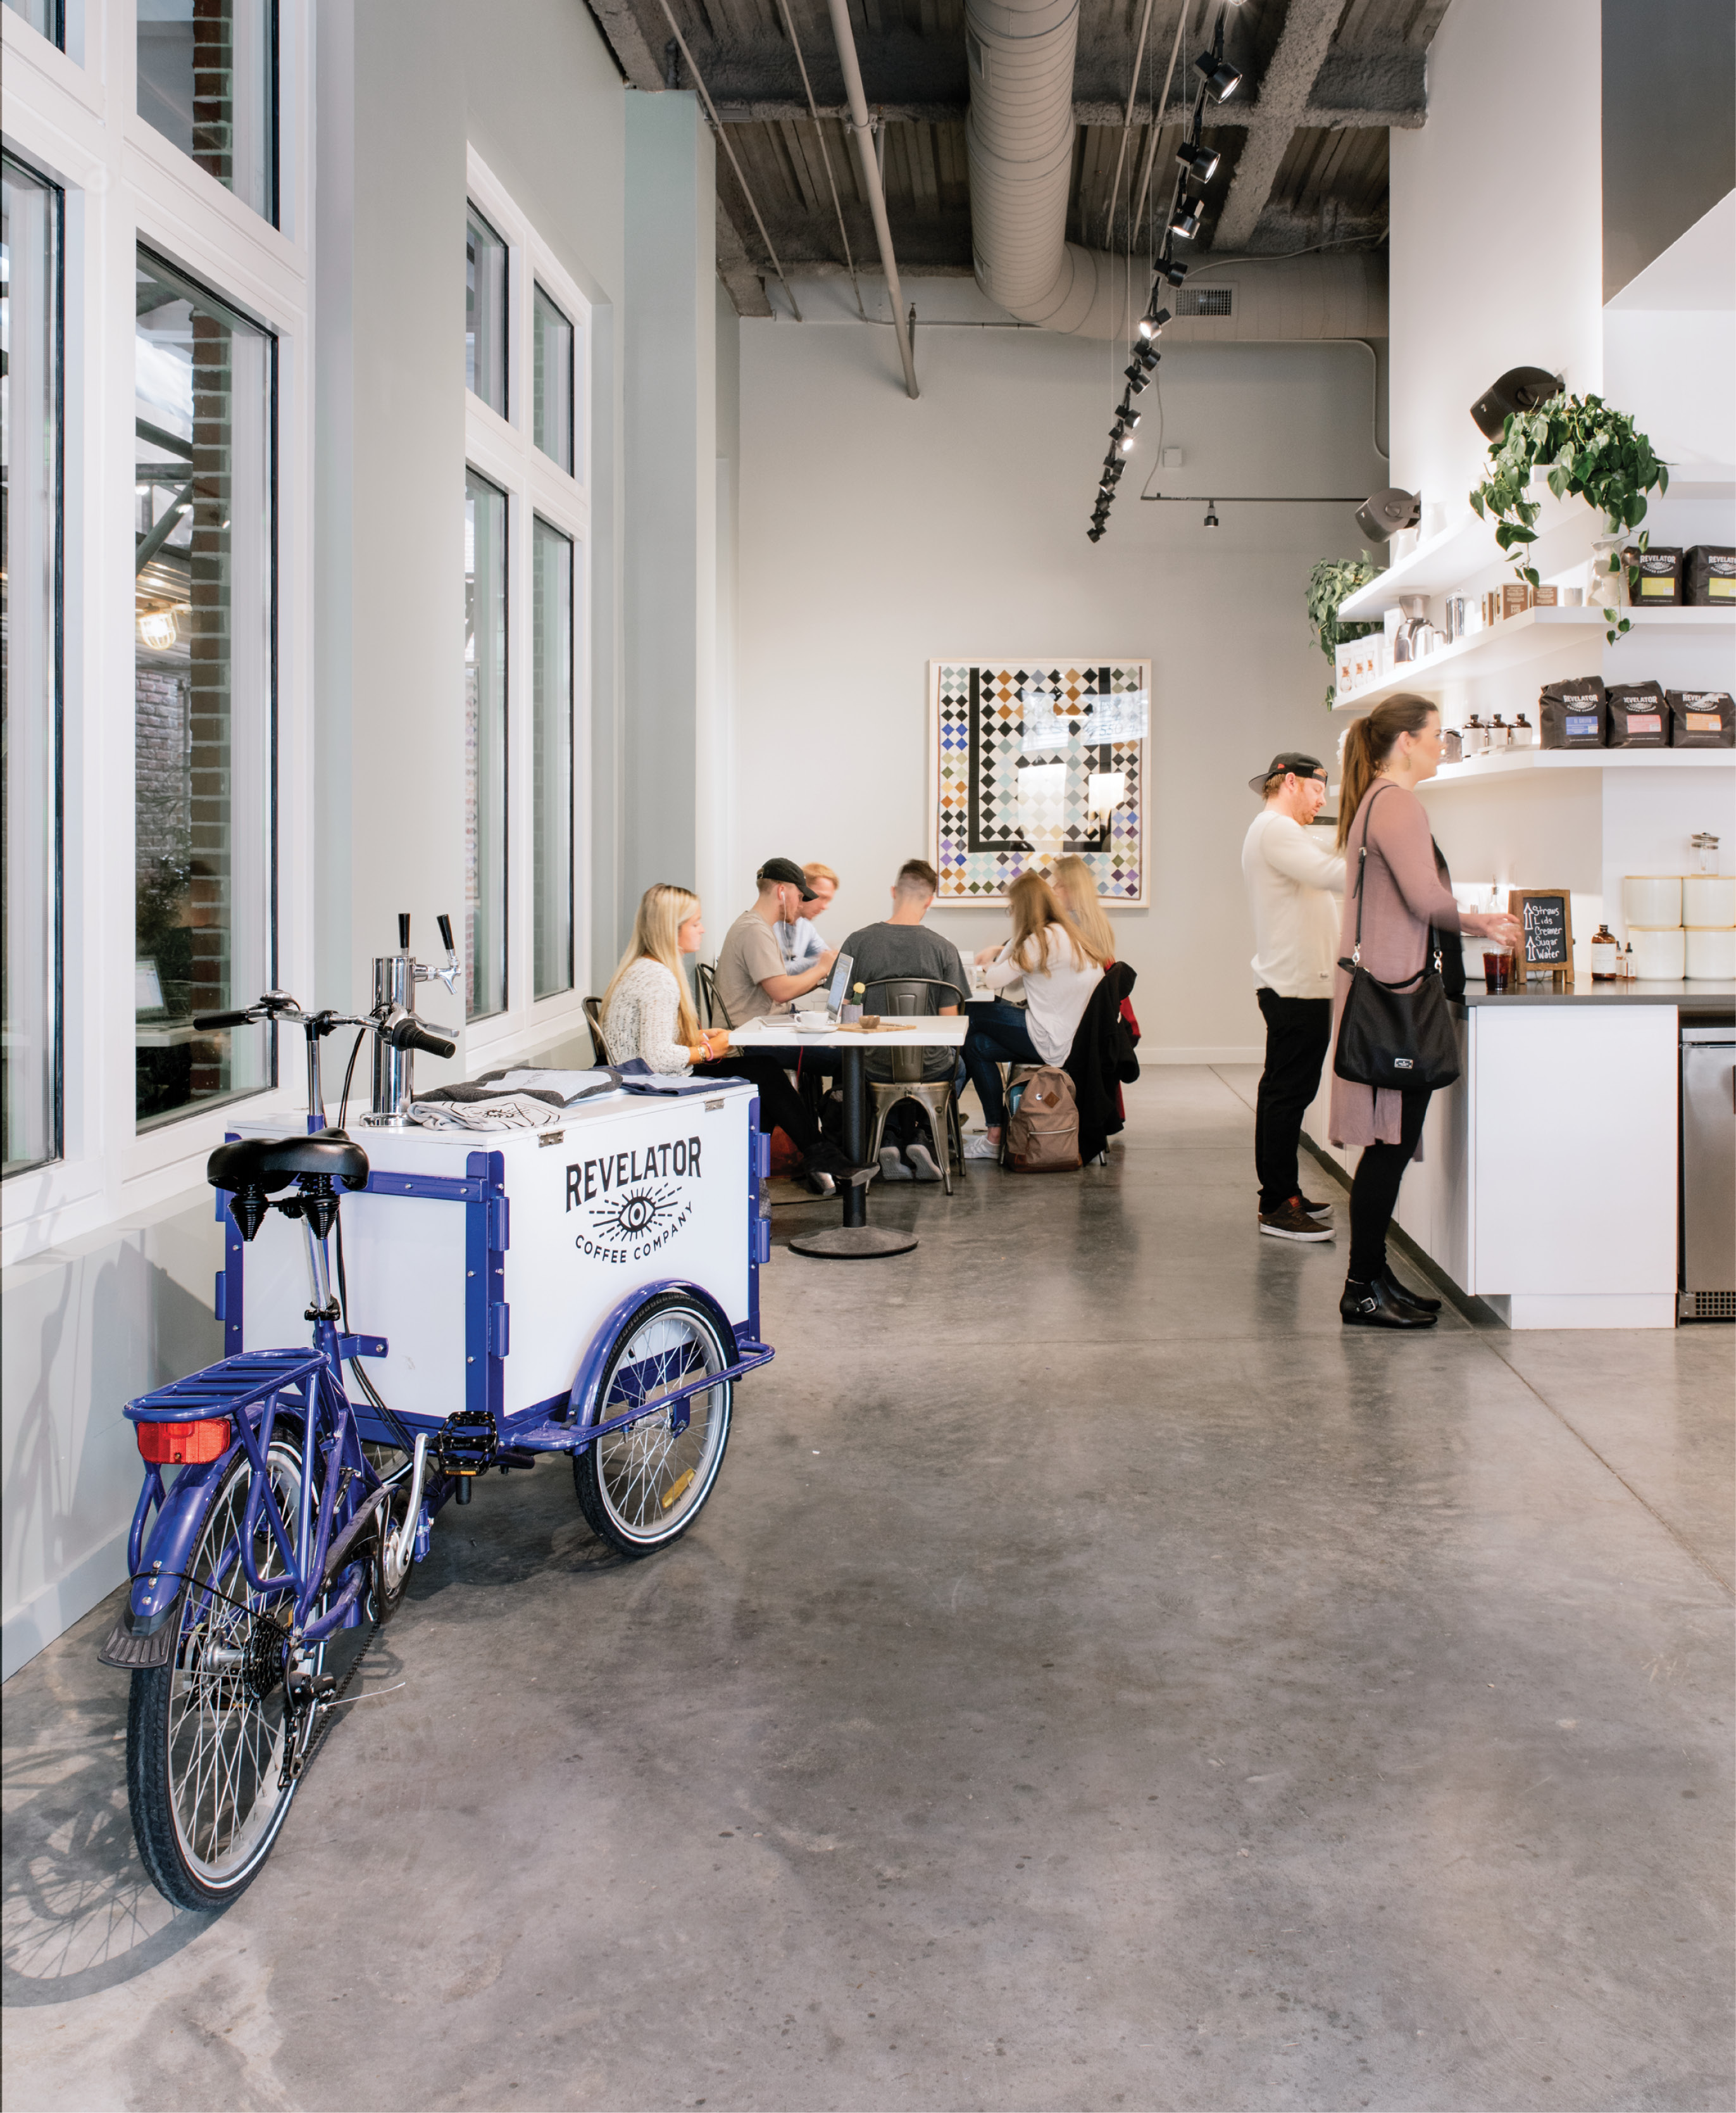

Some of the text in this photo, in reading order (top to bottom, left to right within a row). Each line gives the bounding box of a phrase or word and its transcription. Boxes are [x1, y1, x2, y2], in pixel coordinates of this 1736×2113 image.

[1640, 555, 1676, 564] REVELATOR
[1709, 556, 1735, 564] REVELAT
[1563, 694, 1598, 702] REVELATOR
[1532, 905, 1560, 915] Straws
[1534, 916, 1552, 924] Lids
[1535, 926, 1562, 936] Creamer
[1535, 936, 1558, 950] Sugar
[1536, 948, 1560, 959] Water
[566, 1136, 701, 1213] REVELATOR
[575, 1201, 692, 1263] COFFEE COMPANY
